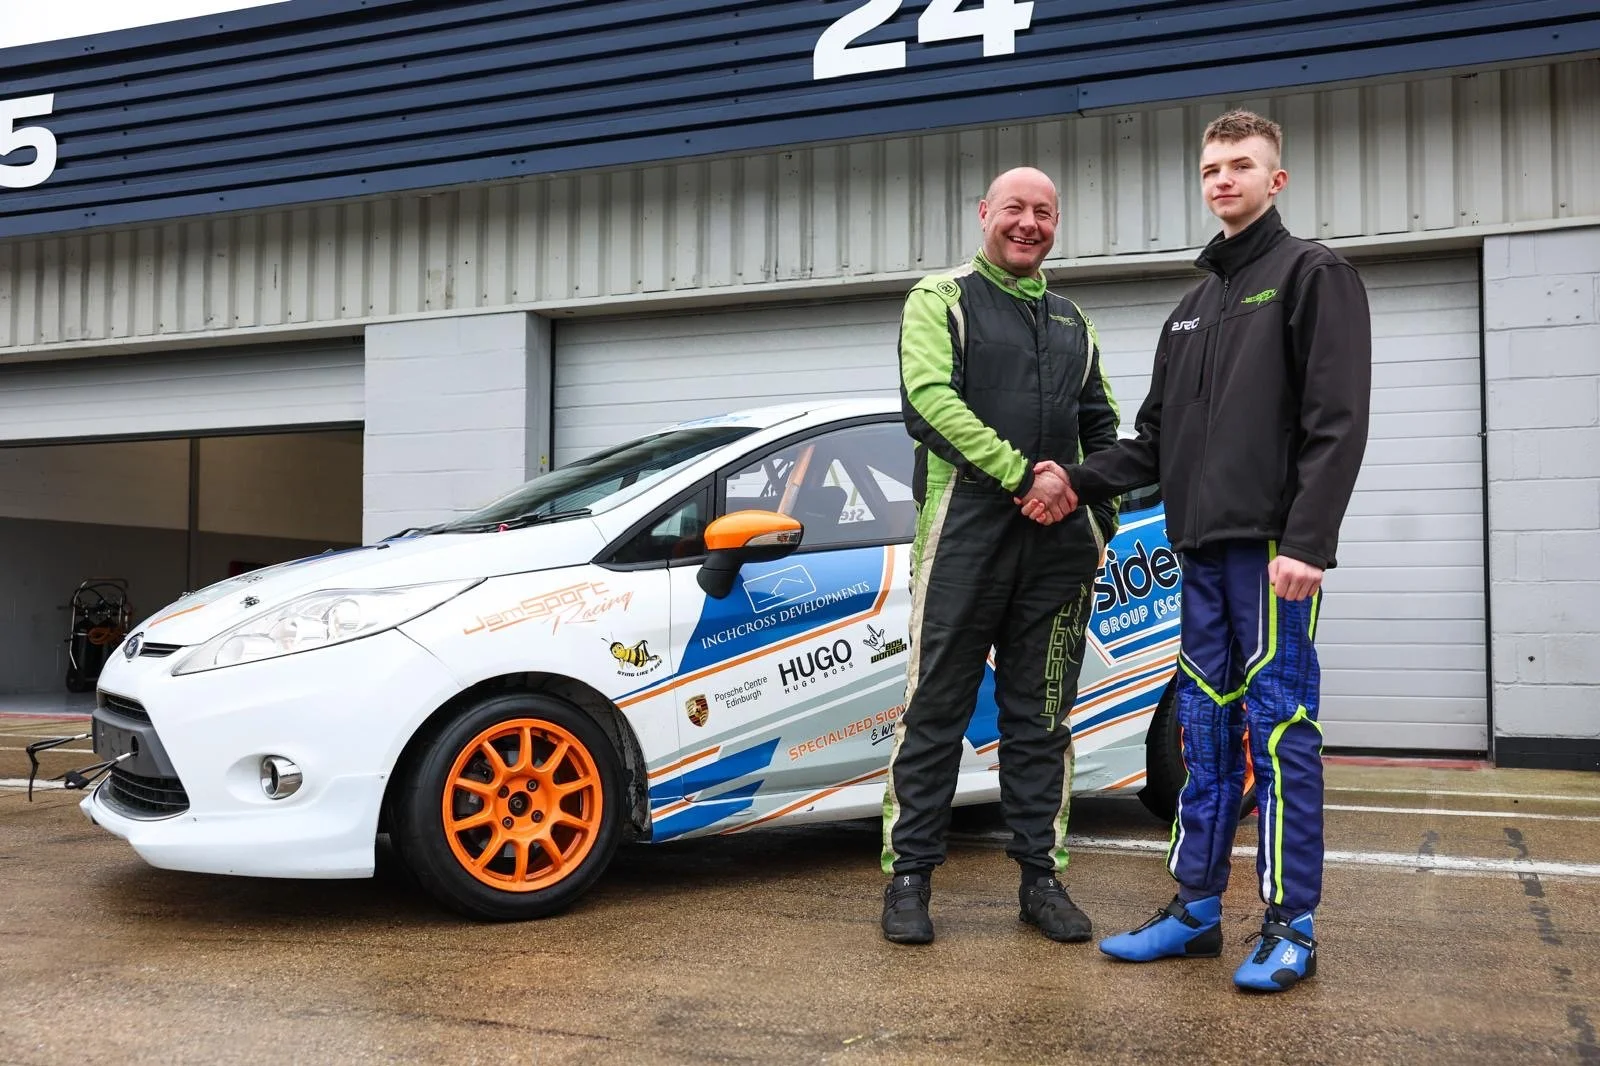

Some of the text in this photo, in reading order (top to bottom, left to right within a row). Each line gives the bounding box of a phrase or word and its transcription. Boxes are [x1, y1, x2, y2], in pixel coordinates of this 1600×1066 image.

[813, 0, 1035, 80] 24
[0, 93, 57, 188] 5
[1093, 538, 1182, 613] side
[463, 581, 610, 635] JamSport
[541, 590, 635, 636] Racing
[701, 580, 871, 650] INCHCROSS DEVELOPMENTS
[1099, 604, 1149, 637] GROUP
[778, 638, 853, 687] HUGO
[870, 642, 908, 665] WONDER
[885, 637, 903, 651] BOY
[714, 675, 768, 703] Porsche Centre
[725, 689, 763, 709] Edinburgh
[784, 661, 855, 695] HUGO BOSS
[788, 716, 873, 761] SPECIALIZED
[870, 727, 878, 741] &
